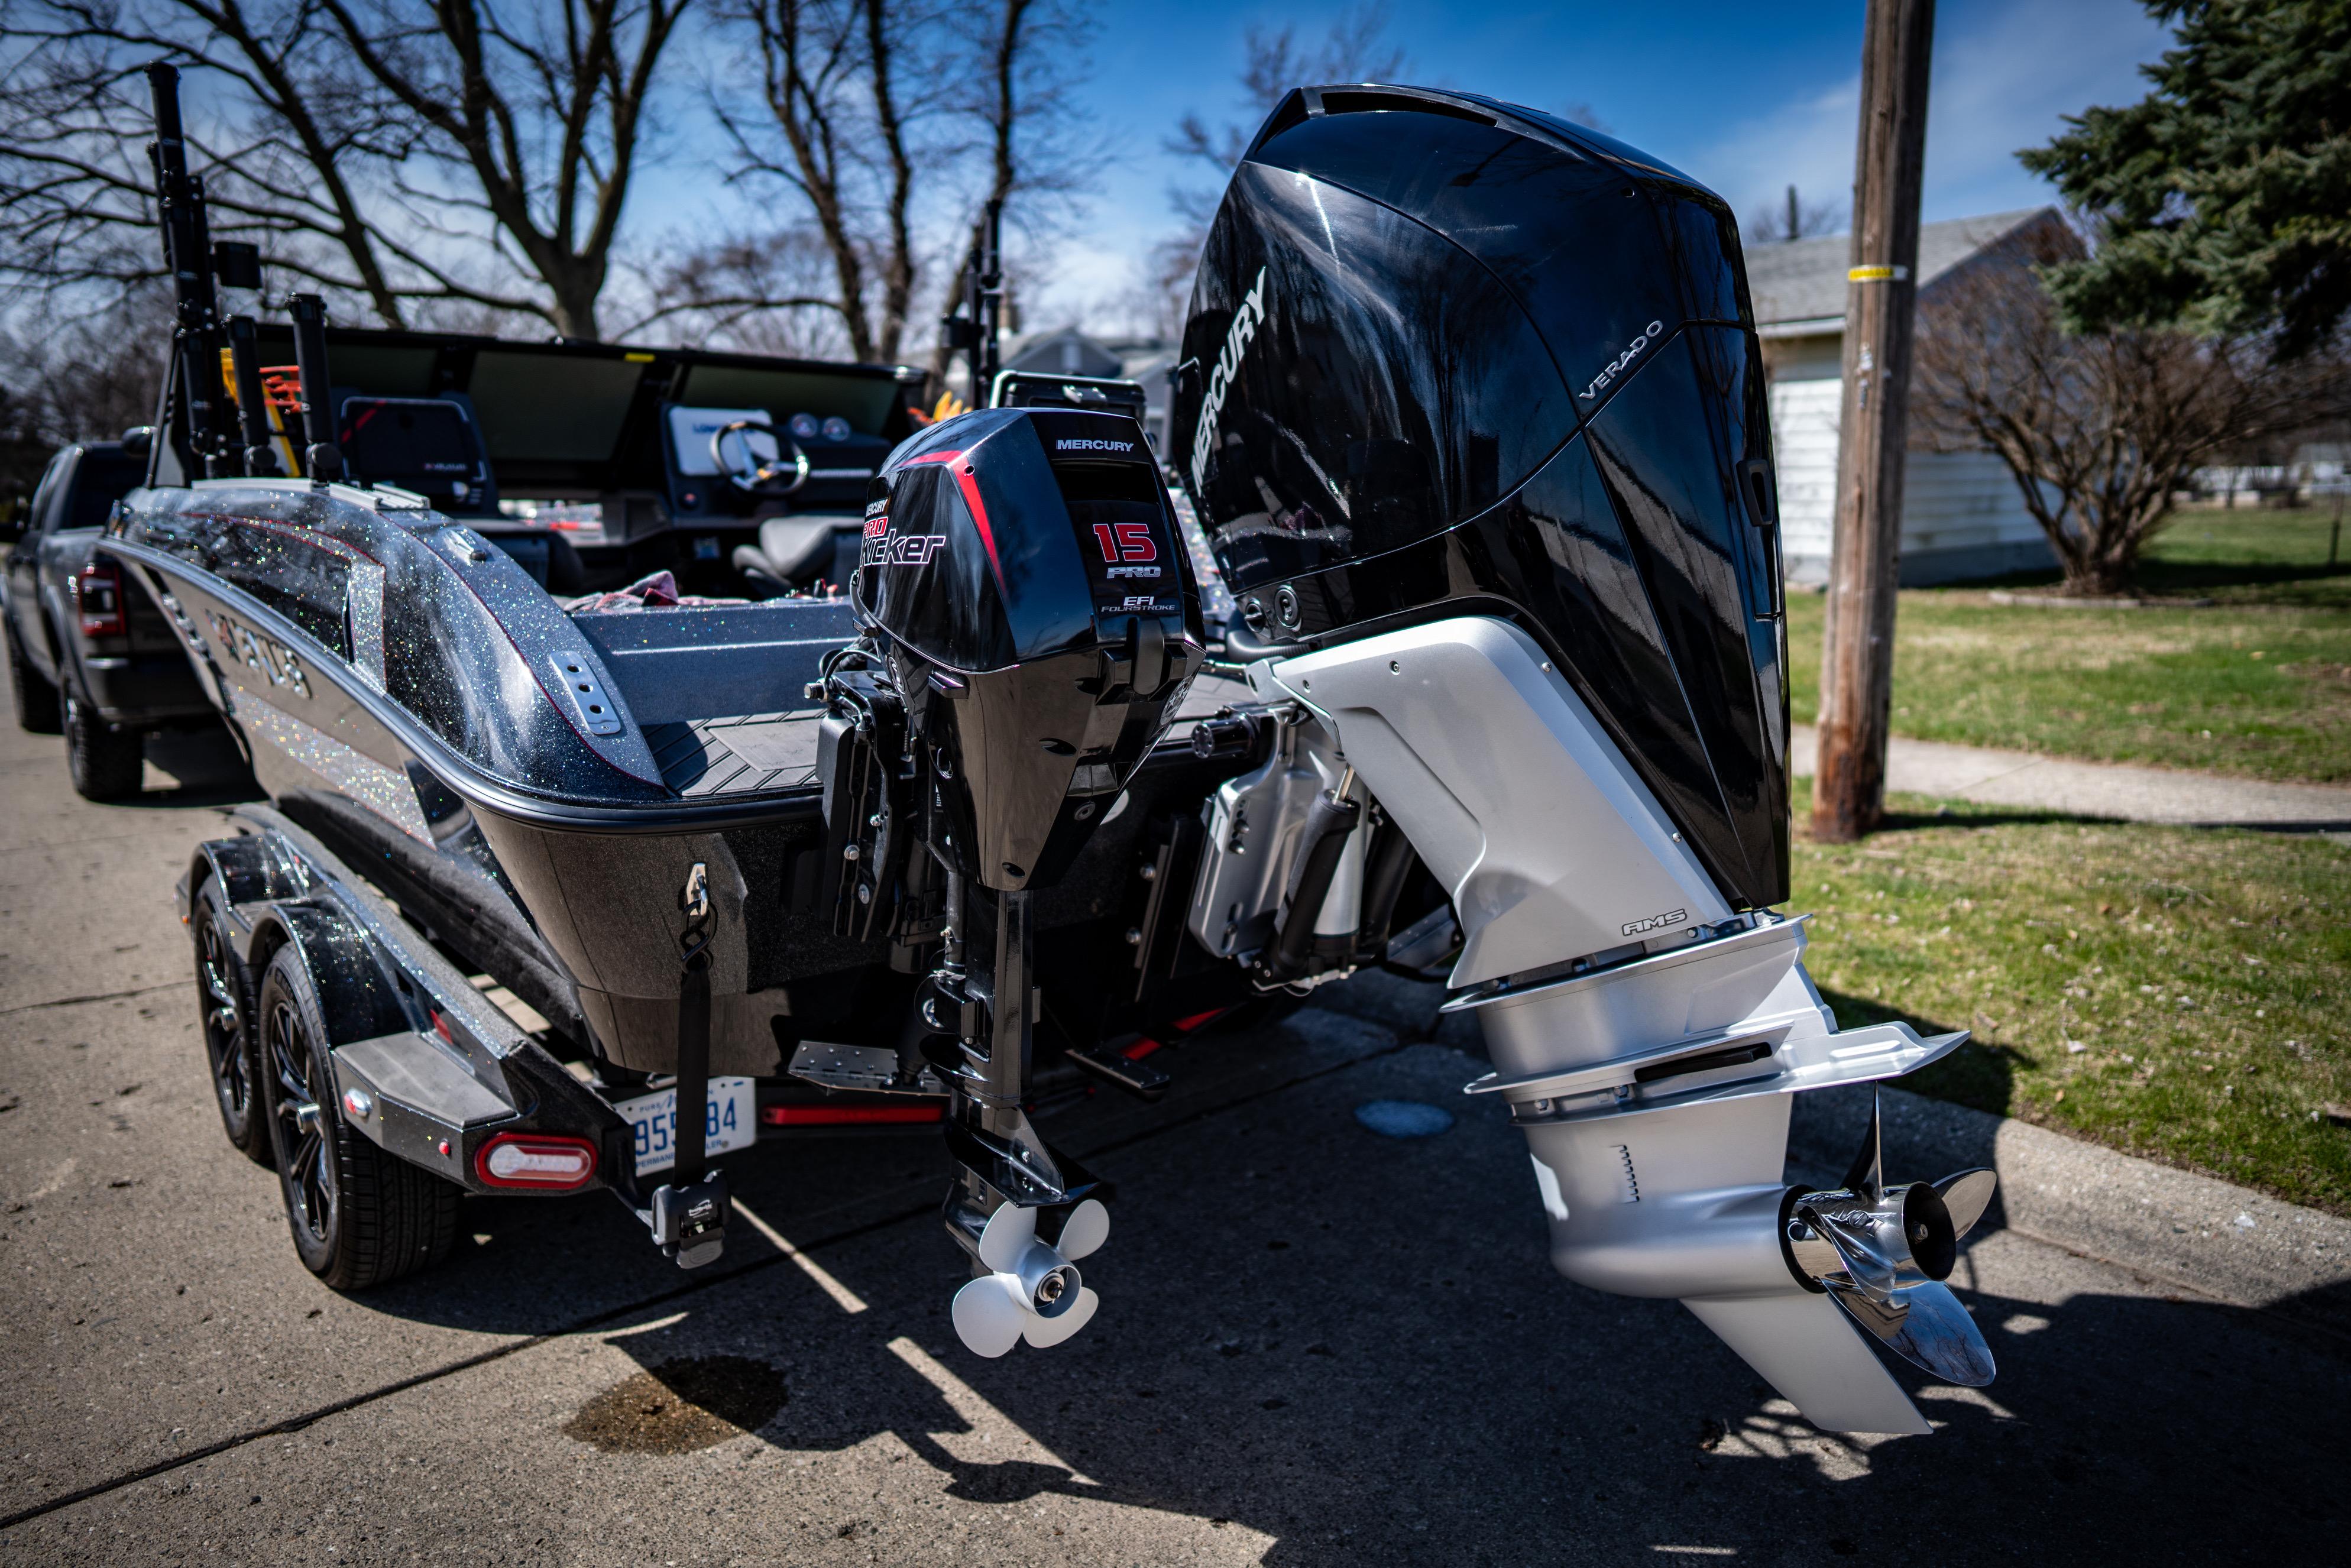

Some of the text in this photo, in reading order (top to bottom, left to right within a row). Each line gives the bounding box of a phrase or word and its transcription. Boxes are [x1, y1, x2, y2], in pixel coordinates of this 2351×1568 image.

[1579, 320, 1663, 399] VERADO
[1191, 265, 1266, 498] MERCURY
[1055, 439, 1134, 452] MERCURY
[865, 498, 888, 518] MERCURY
[863, 516, 889, 539] PRO
[1093, 523, 1157, 562] 15
[1107, 566, 1161, 579] PRO
[1123, 596, 1154, 606] EFI
[1621, 908, 1688, 936] AMS
